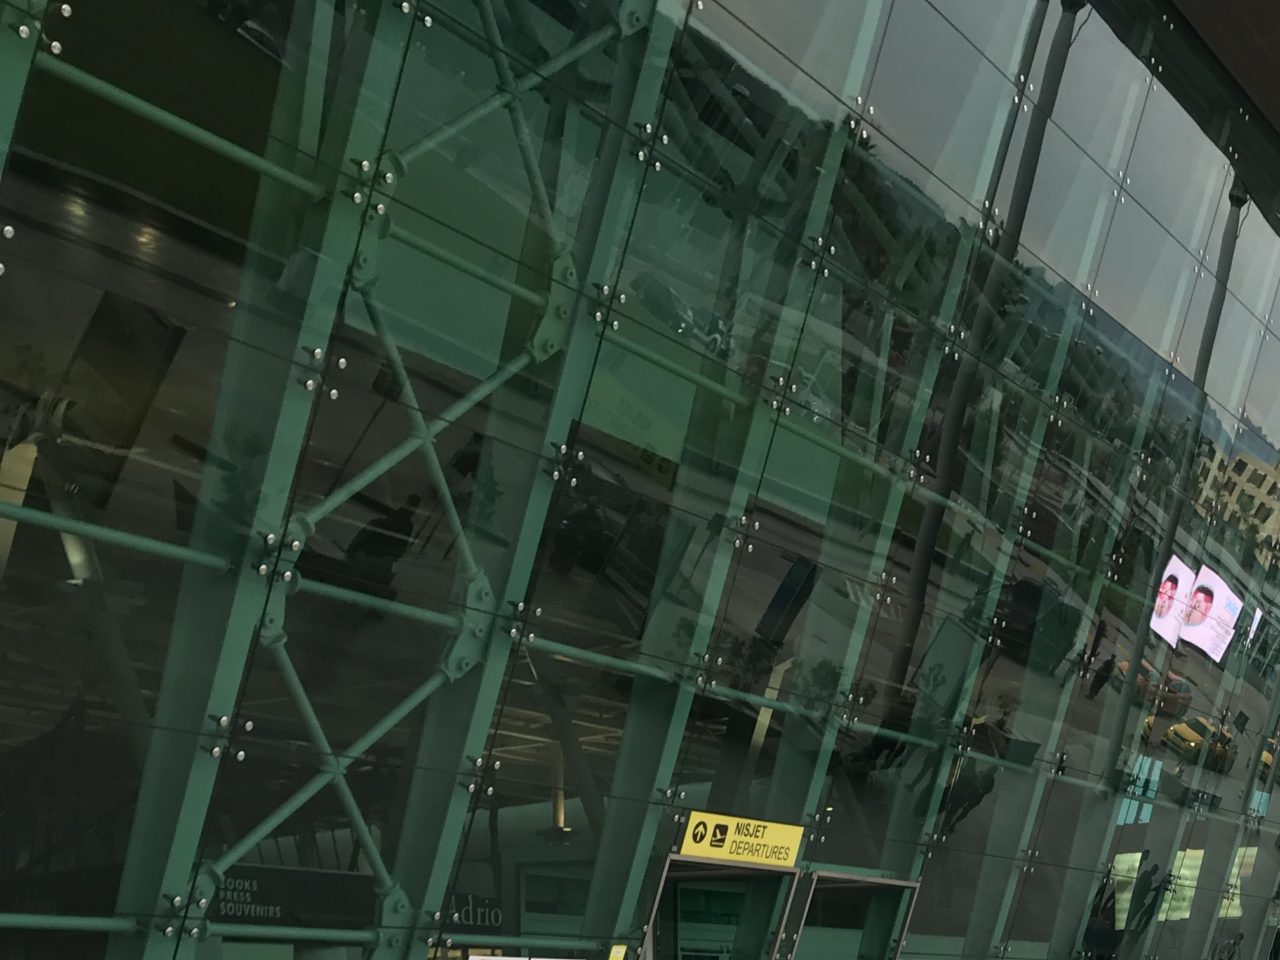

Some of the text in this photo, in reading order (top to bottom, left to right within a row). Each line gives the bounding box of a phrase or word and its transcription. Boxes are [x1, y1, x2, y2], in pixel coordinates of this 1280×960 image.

[734, 822, 768, 839] NISJET
[729, 840, 790, 861] DEPARTURES
[220, 891, 251, 902] PRESS
[220, 902, 281, 918] SOUVENIRS
[446, 894, 502, 926] Adrio
